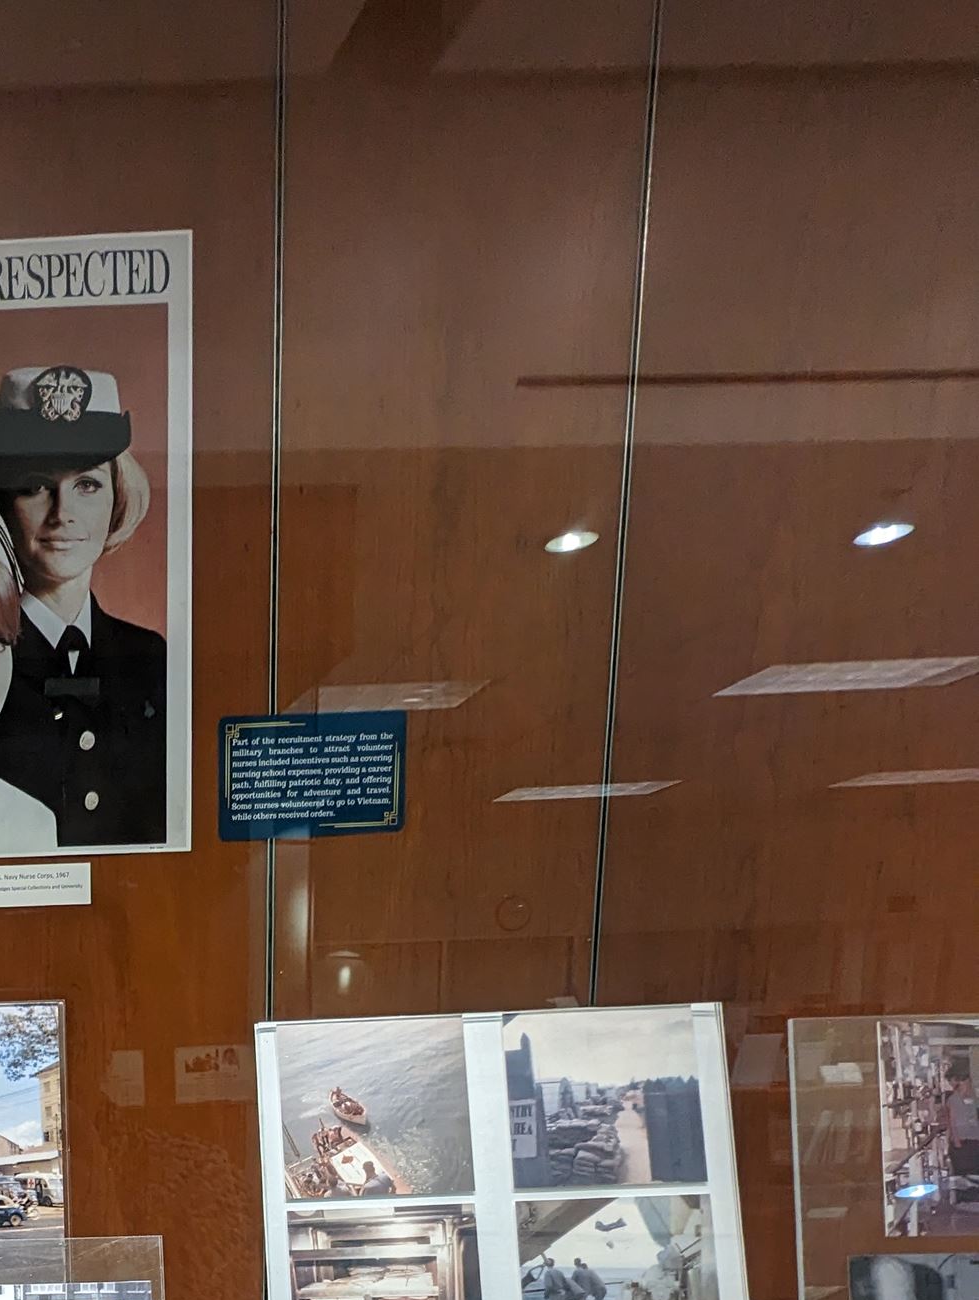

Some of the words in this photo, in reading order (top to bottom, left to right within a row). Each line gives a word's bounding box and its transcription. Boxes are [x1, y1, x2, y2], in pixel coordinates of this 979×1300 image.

[232, 738, 248, 746] Part
[251, 737, 260, 745] of
[261, 736, 275, 744] the
[277, 735, 322, 744] recruitment
[325, 734, 356, 742] strategy
[359, 732, 377, 741] from
[232, 748, 262, 757] military
[268, 746, 303, 755] branches
[356, 743, 393, 751] volunteer
